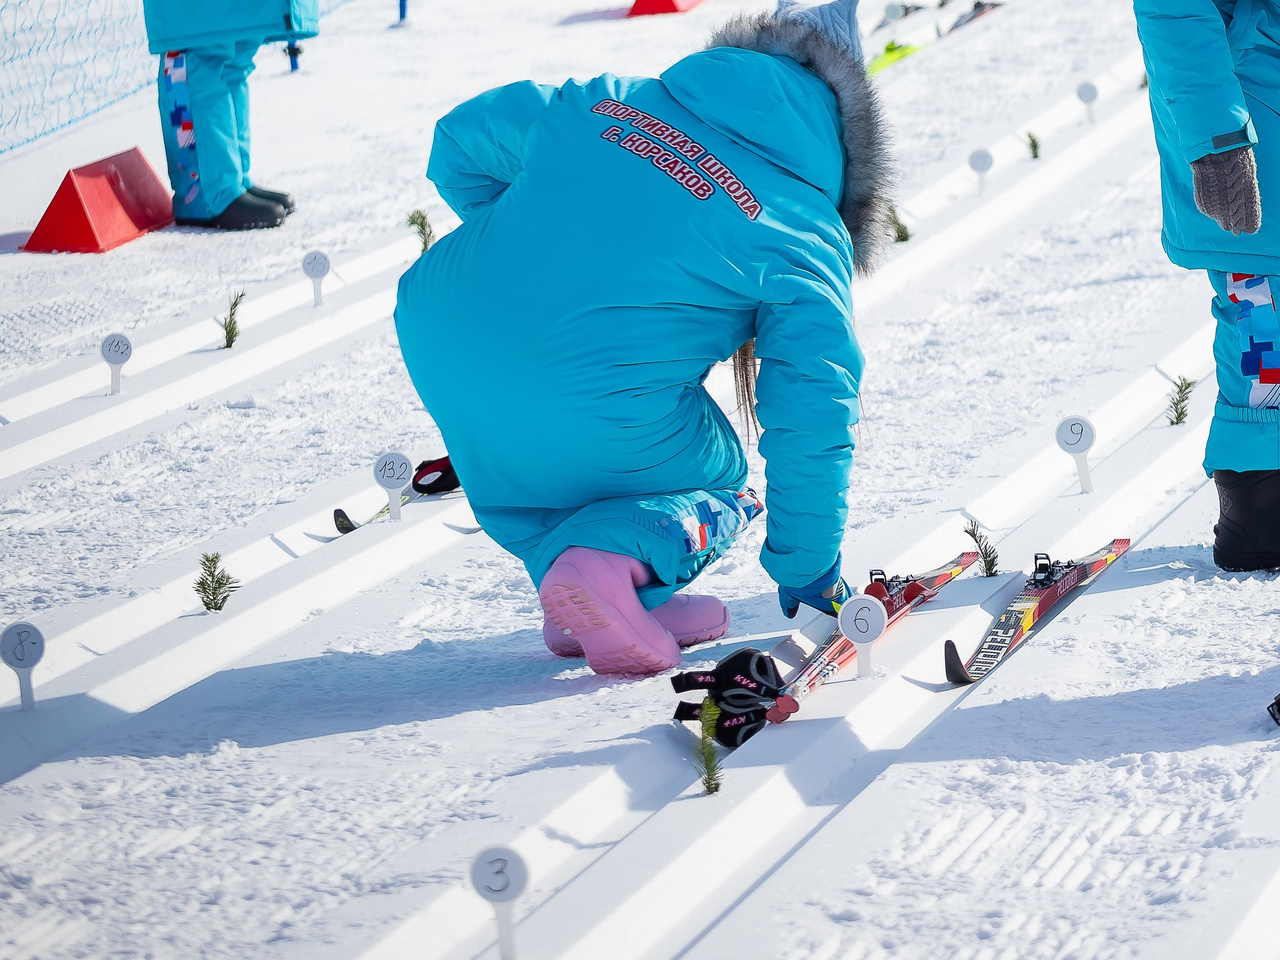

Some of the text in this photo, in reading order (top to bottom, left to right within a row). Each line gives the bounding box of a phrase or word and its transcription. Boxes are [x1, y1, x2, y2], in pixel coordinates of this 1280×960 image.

[591, 99, 763, 221] СПОРТИВНАЯ ШКОЛА
[618, 132, 716, 201] КОРСАКОВ
[1064, 422, 1084, 446] 9
[378, 460, 408, 481] 132
[853, 606, 871, 634] 6
[485, 857, 511, 893] 3
